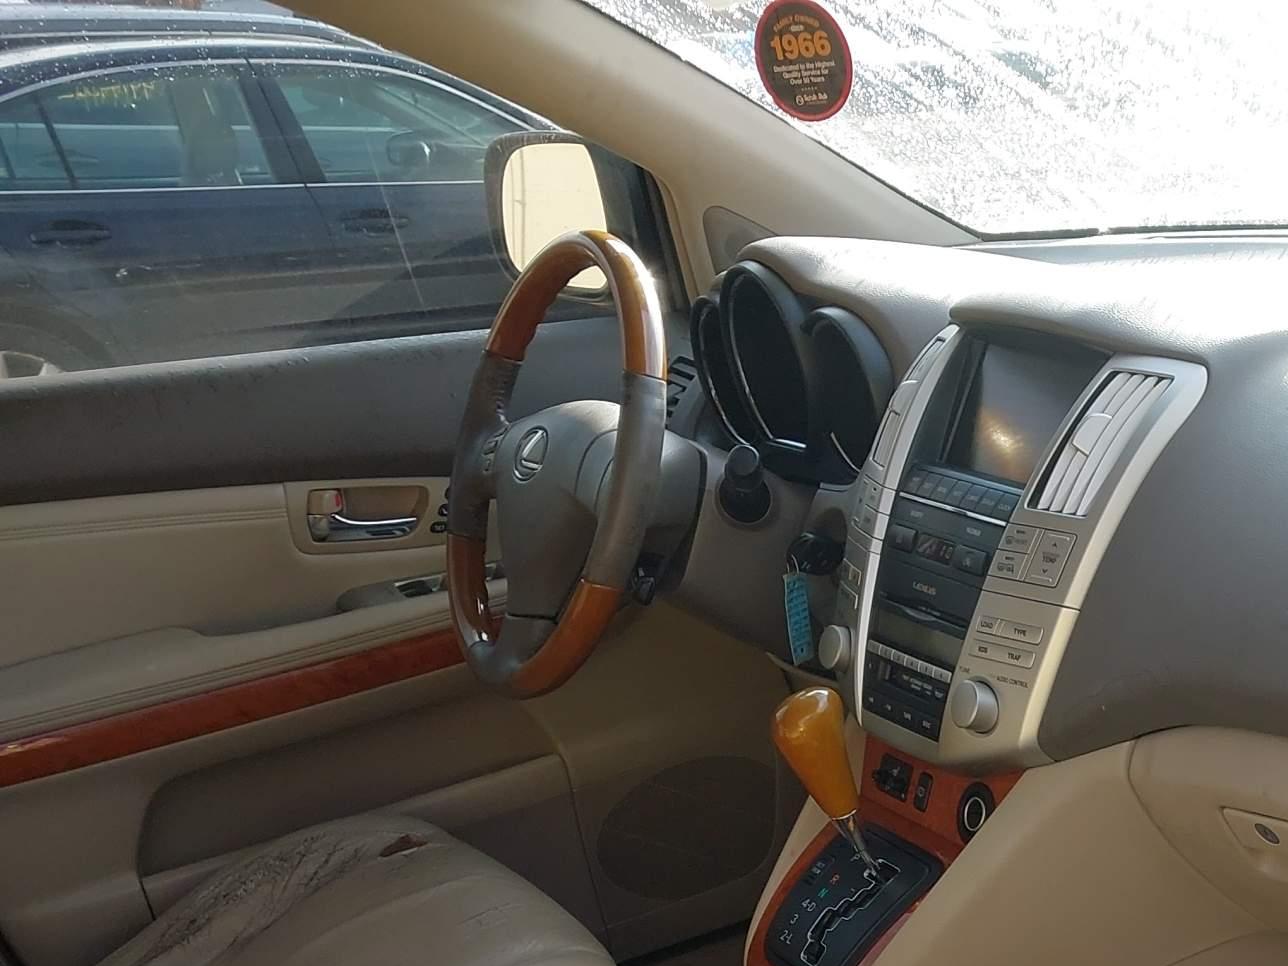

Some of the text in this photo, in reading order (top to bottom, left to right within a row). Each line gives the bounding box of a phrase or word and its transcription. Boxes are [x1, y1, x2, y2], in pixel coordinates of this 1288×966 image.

[770, 30, 832, 61] 1966
[1014, 627, 1027, 637] TYPE
[830, 873, 841, 885] R
[817, 887, 829, 899] N
[790, 914, 799, 924] 3
